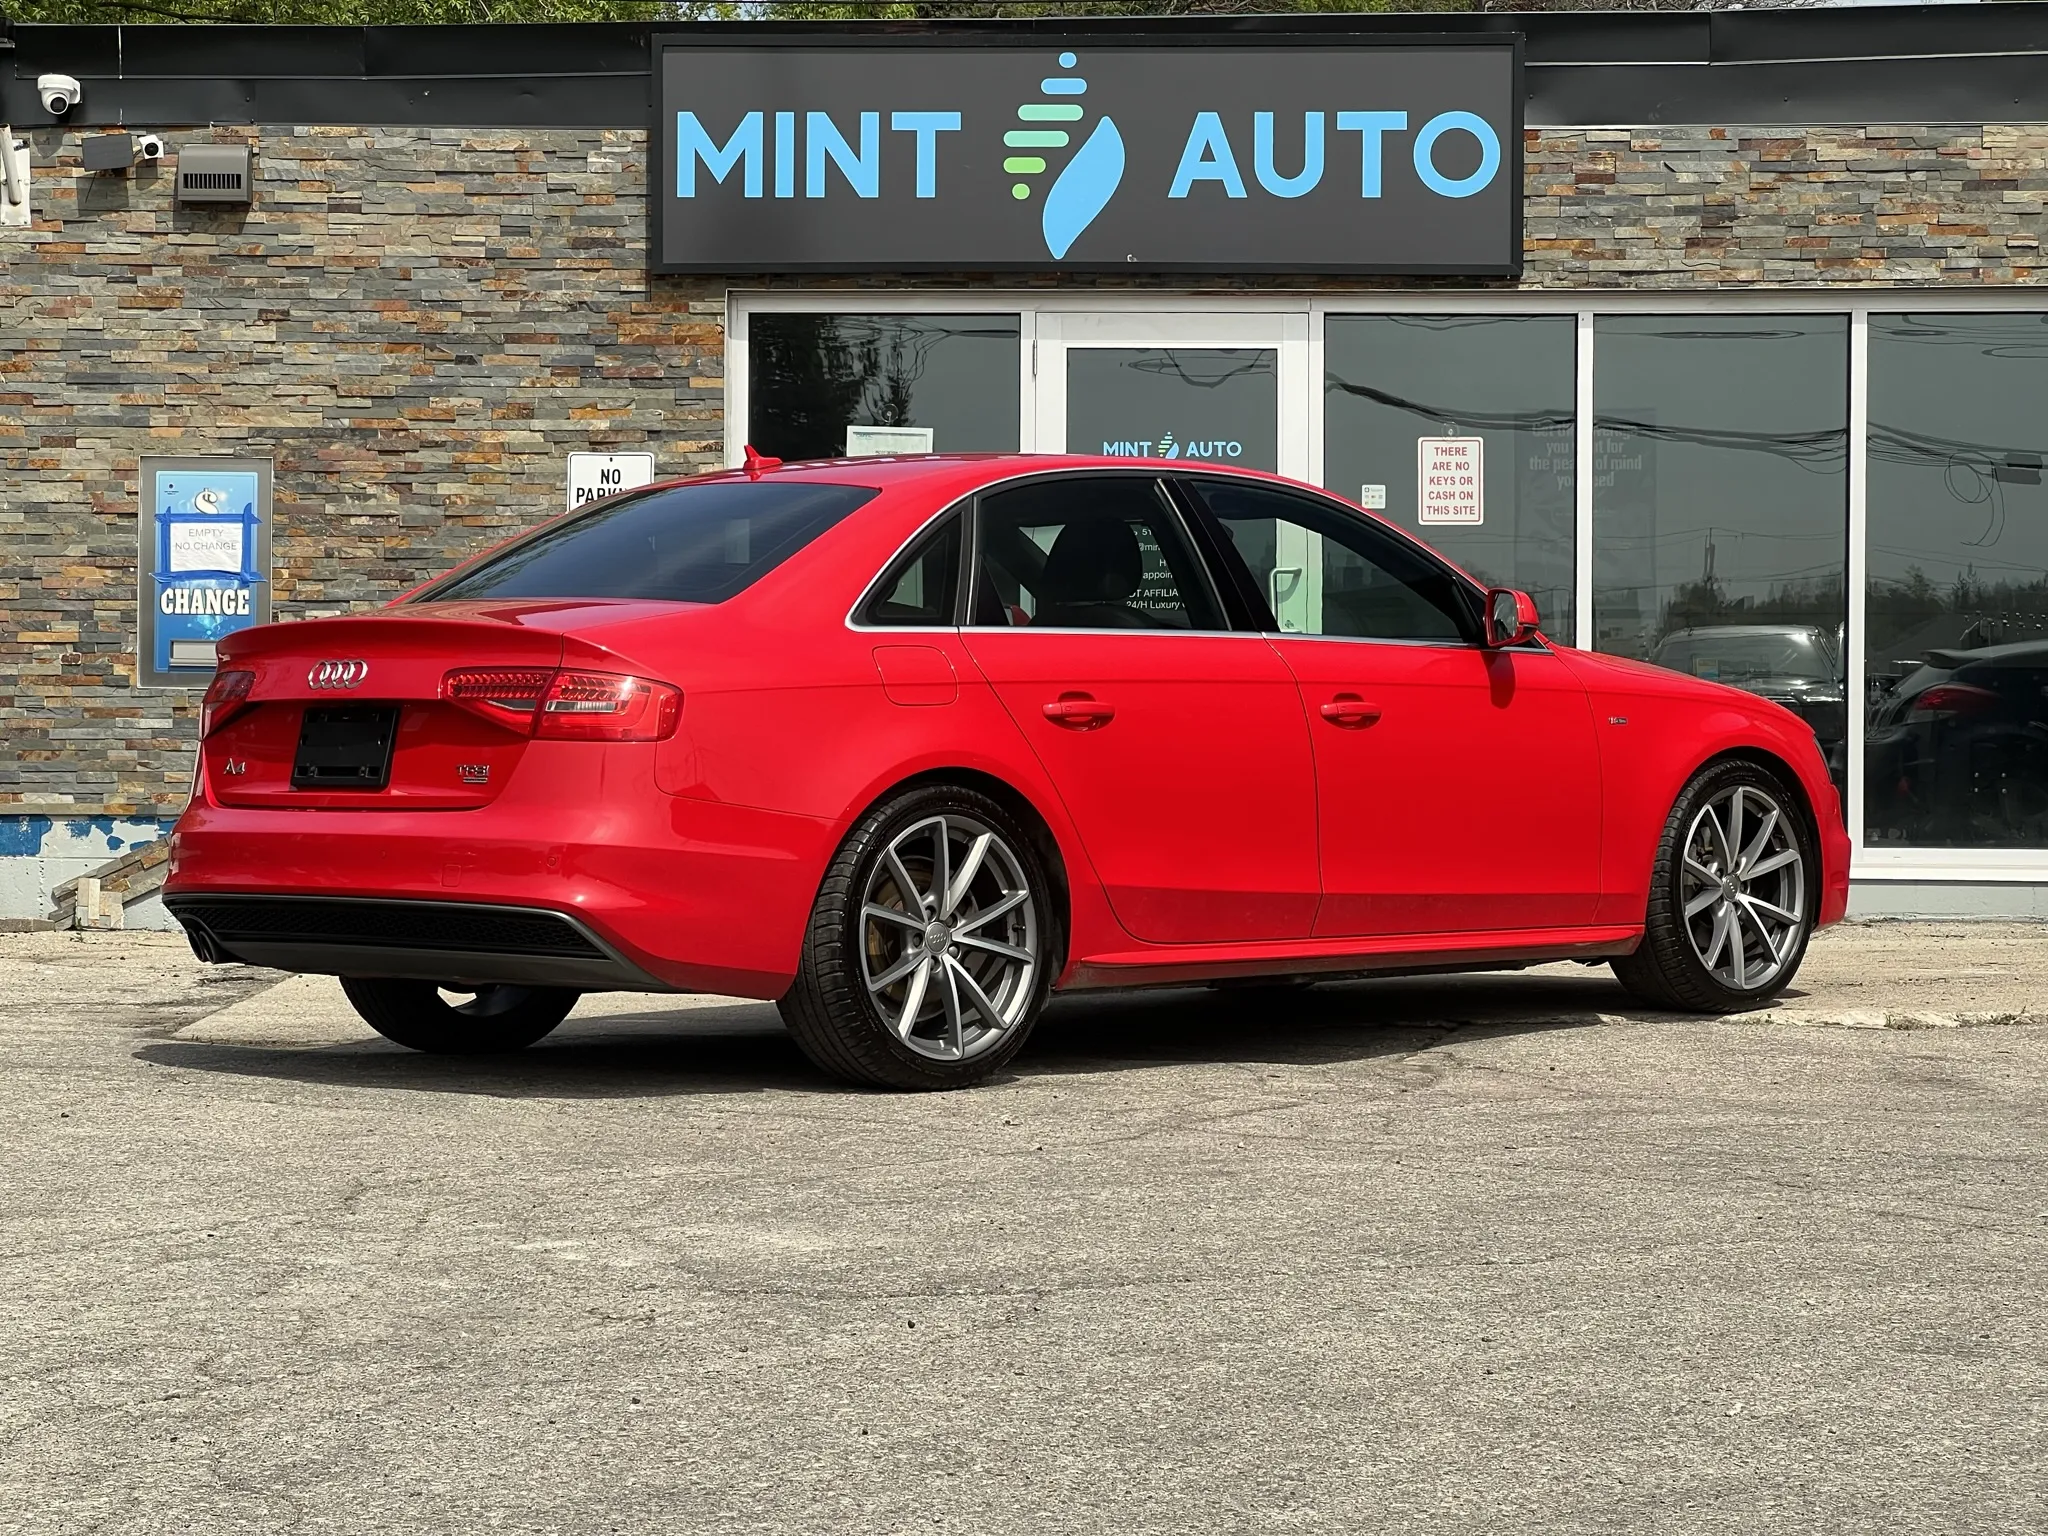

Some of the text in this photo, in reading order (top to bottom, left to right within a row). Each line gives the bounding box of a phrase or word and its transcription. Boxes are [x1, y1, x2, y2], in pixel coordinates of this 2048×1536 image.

[676, 111, 1501, 198] MINT AUTO
[1103, 441, 1242, 457] MINT AUTO
[1434, 447, 1468, 456] THERE
[1432, 462, 1470, 471] ARE NO
[601, 469, 621, 484] NO
[1429, 476, 1474, 486] KEYS OR
[1428, 491, 1474, 501] CASH ON
[1426, 506, 1476, 515] THIS SITE
[188, 529, 225, 538] EMPTY
[175, 541, 237, 551] NO CHANGE
[1142, 571, 1173, 581] appoin
[1143, 588, 1179, 597] AFFILIA
[160, 587, 250, 615] CHANGE
[1150, 600, 1181, 611] Luxury
[223, 757, 246, 775] A4
